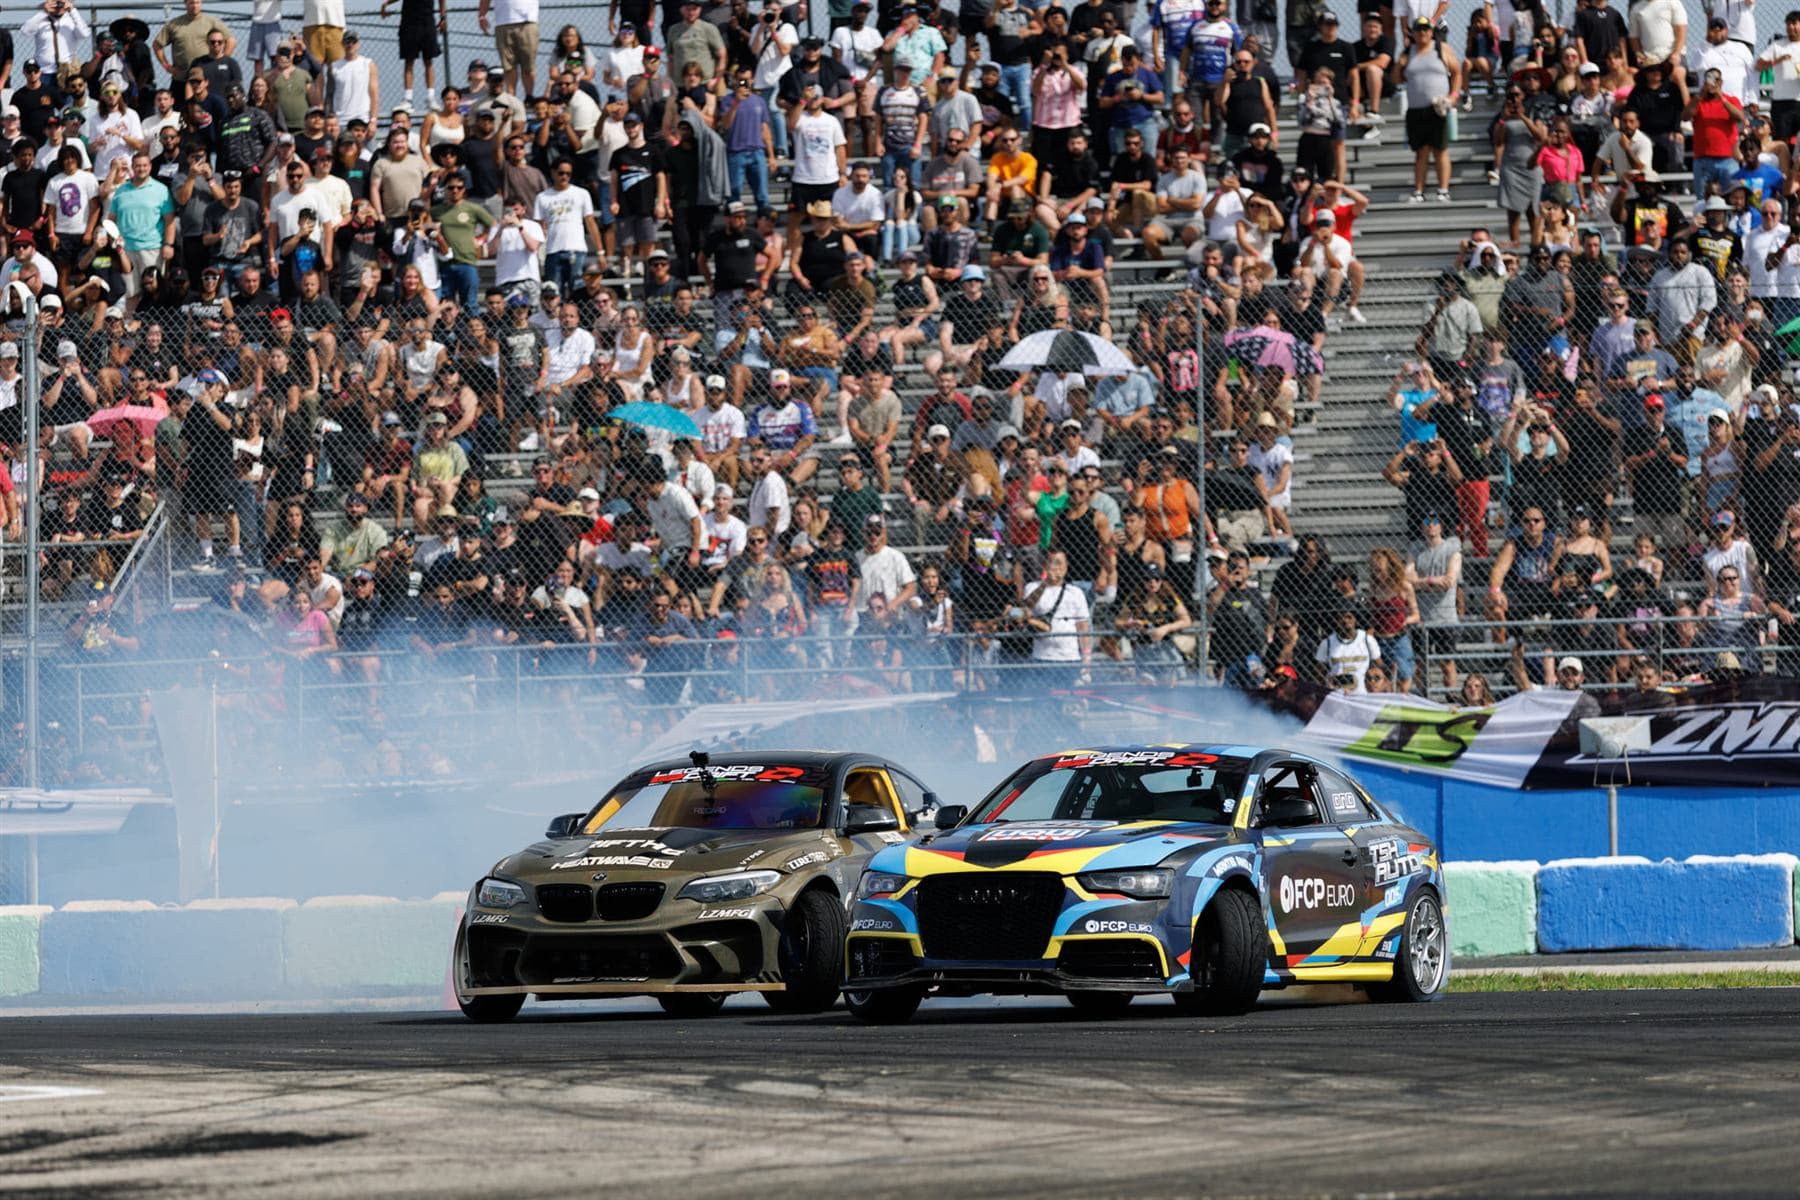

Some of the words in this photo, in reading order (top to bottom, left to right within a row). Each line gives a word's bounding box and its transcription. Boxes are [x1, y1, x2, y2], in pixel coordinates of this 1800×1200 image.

[1058, 752, 1175, 763] LEGENDS
[1369, 841, 1400, 868] TSH
[550, 856, 652, 870] HEATWAVE
[1376, 855, 1421, 883] AUTO
[1294, 878, 1326, 909] FCP
[1326, 884, 1355, 907] EURO
[472, 914, 510, 923] LZMFG
[697, 909, 750, 919] LZMFG
[857, 919, 875, 929] FCP
[874, 921, 893, 929] EURO
[1100, 920, 1127, 932] FCP
[1128, 923, 1153, 933] EURO
